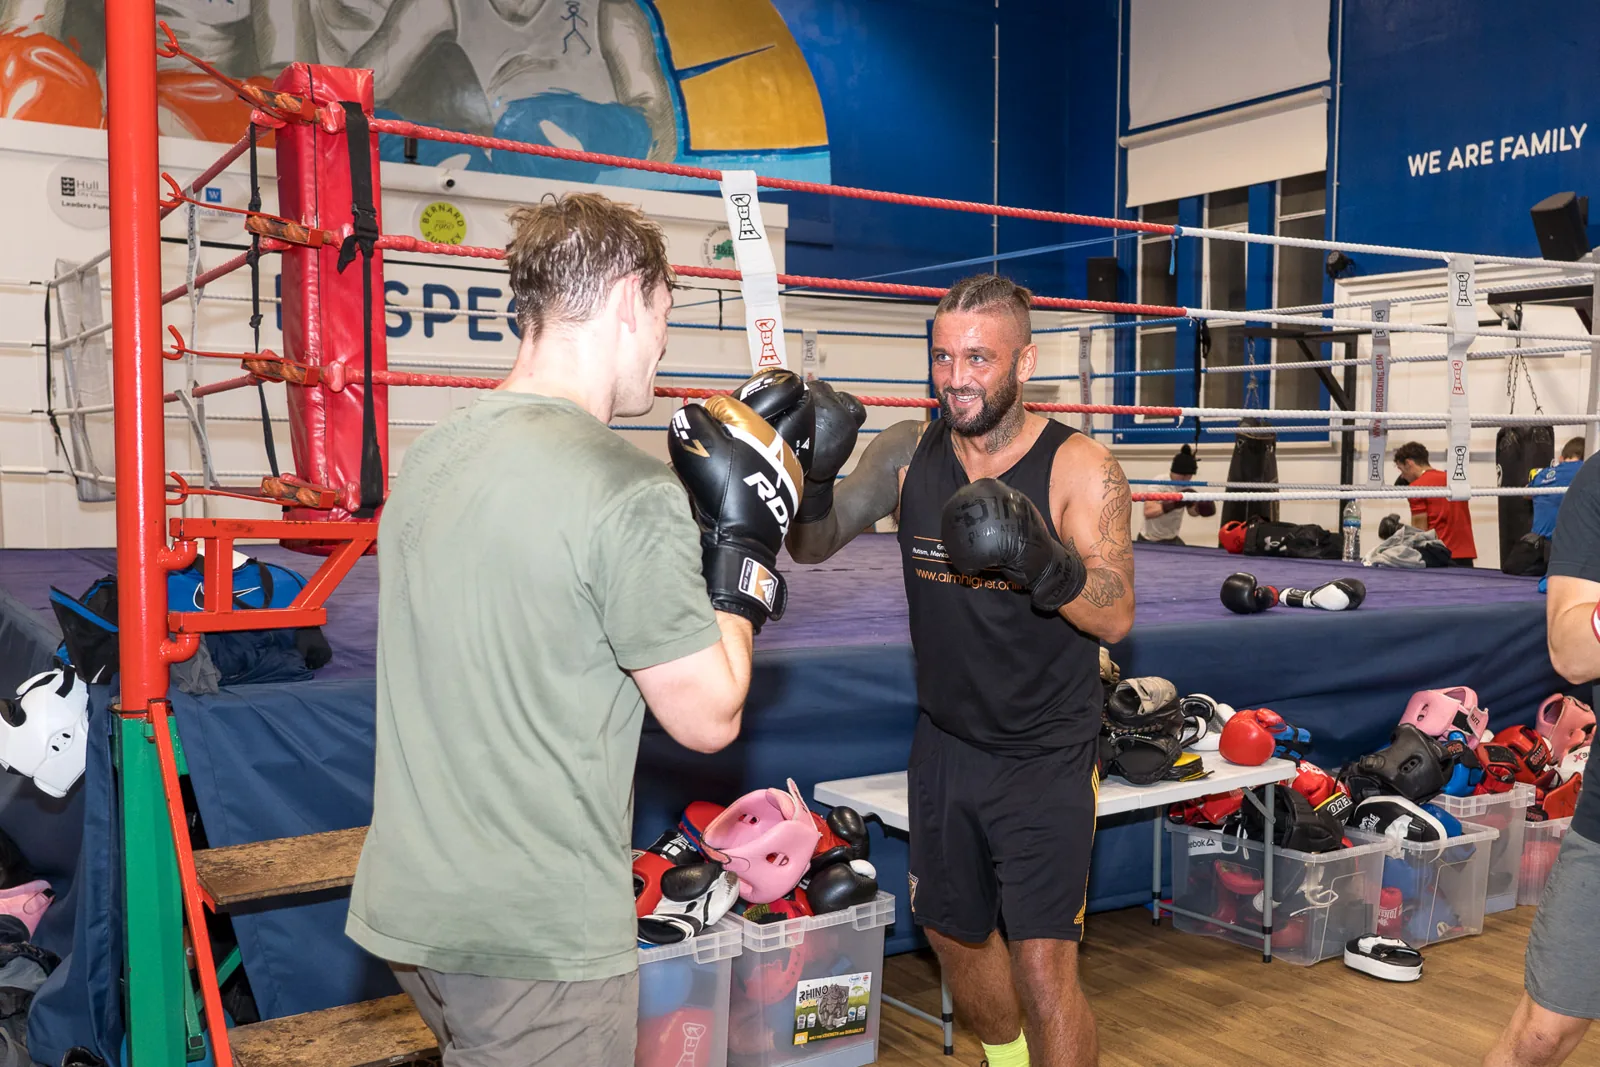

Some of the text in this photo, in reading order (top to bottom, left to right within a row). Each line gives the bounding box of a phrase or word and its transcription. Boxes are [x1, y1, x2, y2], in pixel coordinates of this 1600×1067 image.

[1407, 123, 1588, 177] WE ARE FAMILY
[76, 179, 99, 190] Hull
[61, 200, 110, 210] Leaders Fun
[422, 204, 465, 227] BERNARD
[1373, 353, 1386, 438] WWWRGOBOXING.COM
[742, 471, 790, 542] RDX
[930, 550, 949, 559] Menta
[799, 984, 829, 1003] RHINO
